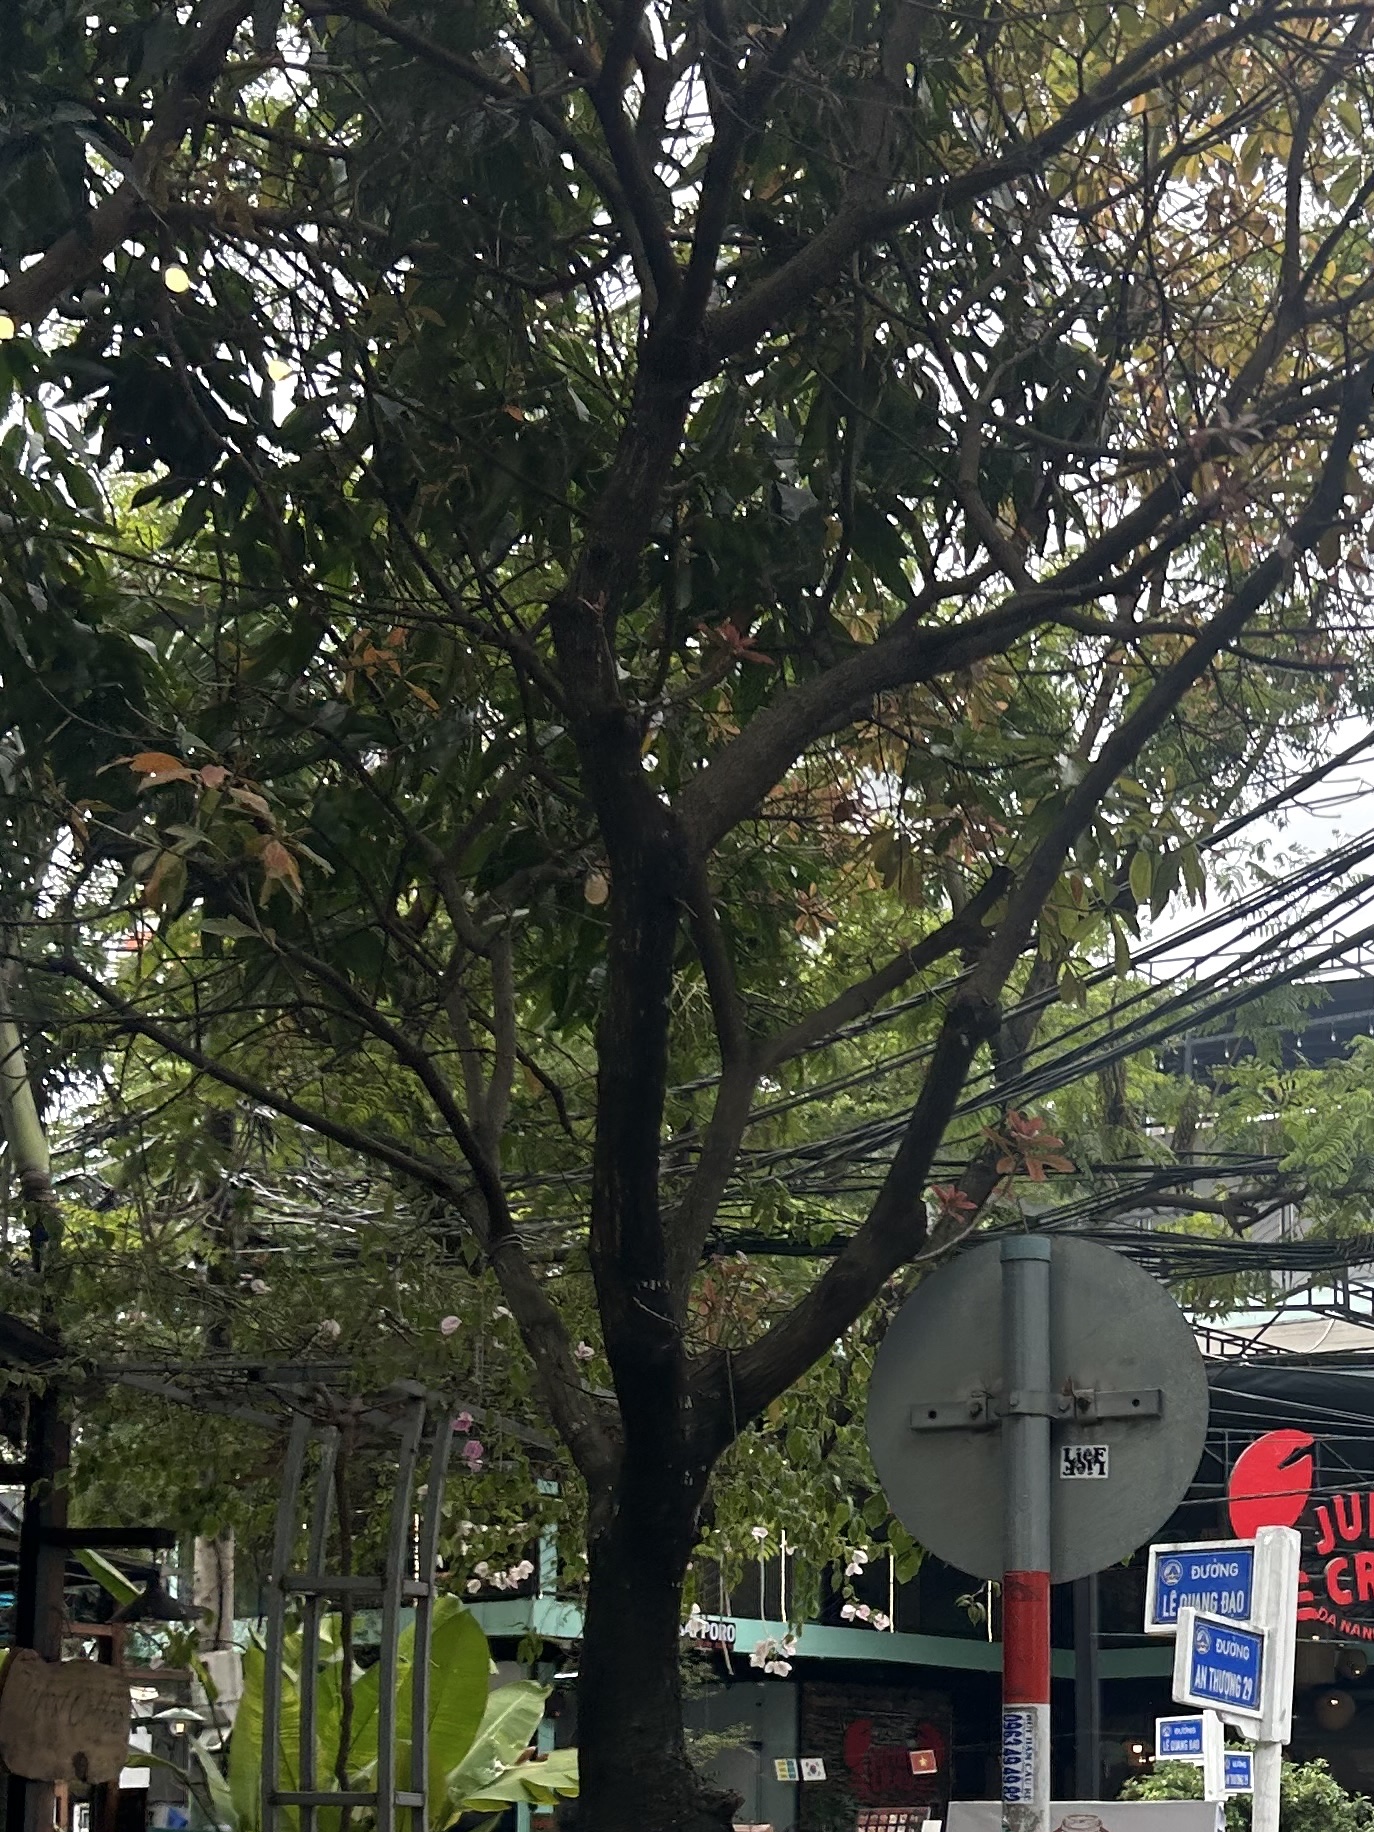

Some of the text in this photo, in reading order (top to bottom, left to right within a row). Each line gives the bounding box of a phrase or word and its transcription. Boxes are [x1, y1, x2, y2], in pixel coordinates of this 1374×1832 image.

[1191, 1558, 1239, 1580] ĐƯỜNG
[1162, 1590, 1177, 1617] LÊ
[1221, 1590, 1245, 1618] ĐẠO
[1318, 1607, 1337, 1626] DA
[1194, 1664, 1208, 1690] AN
[1242, 1676, 1253, 1701] 29
